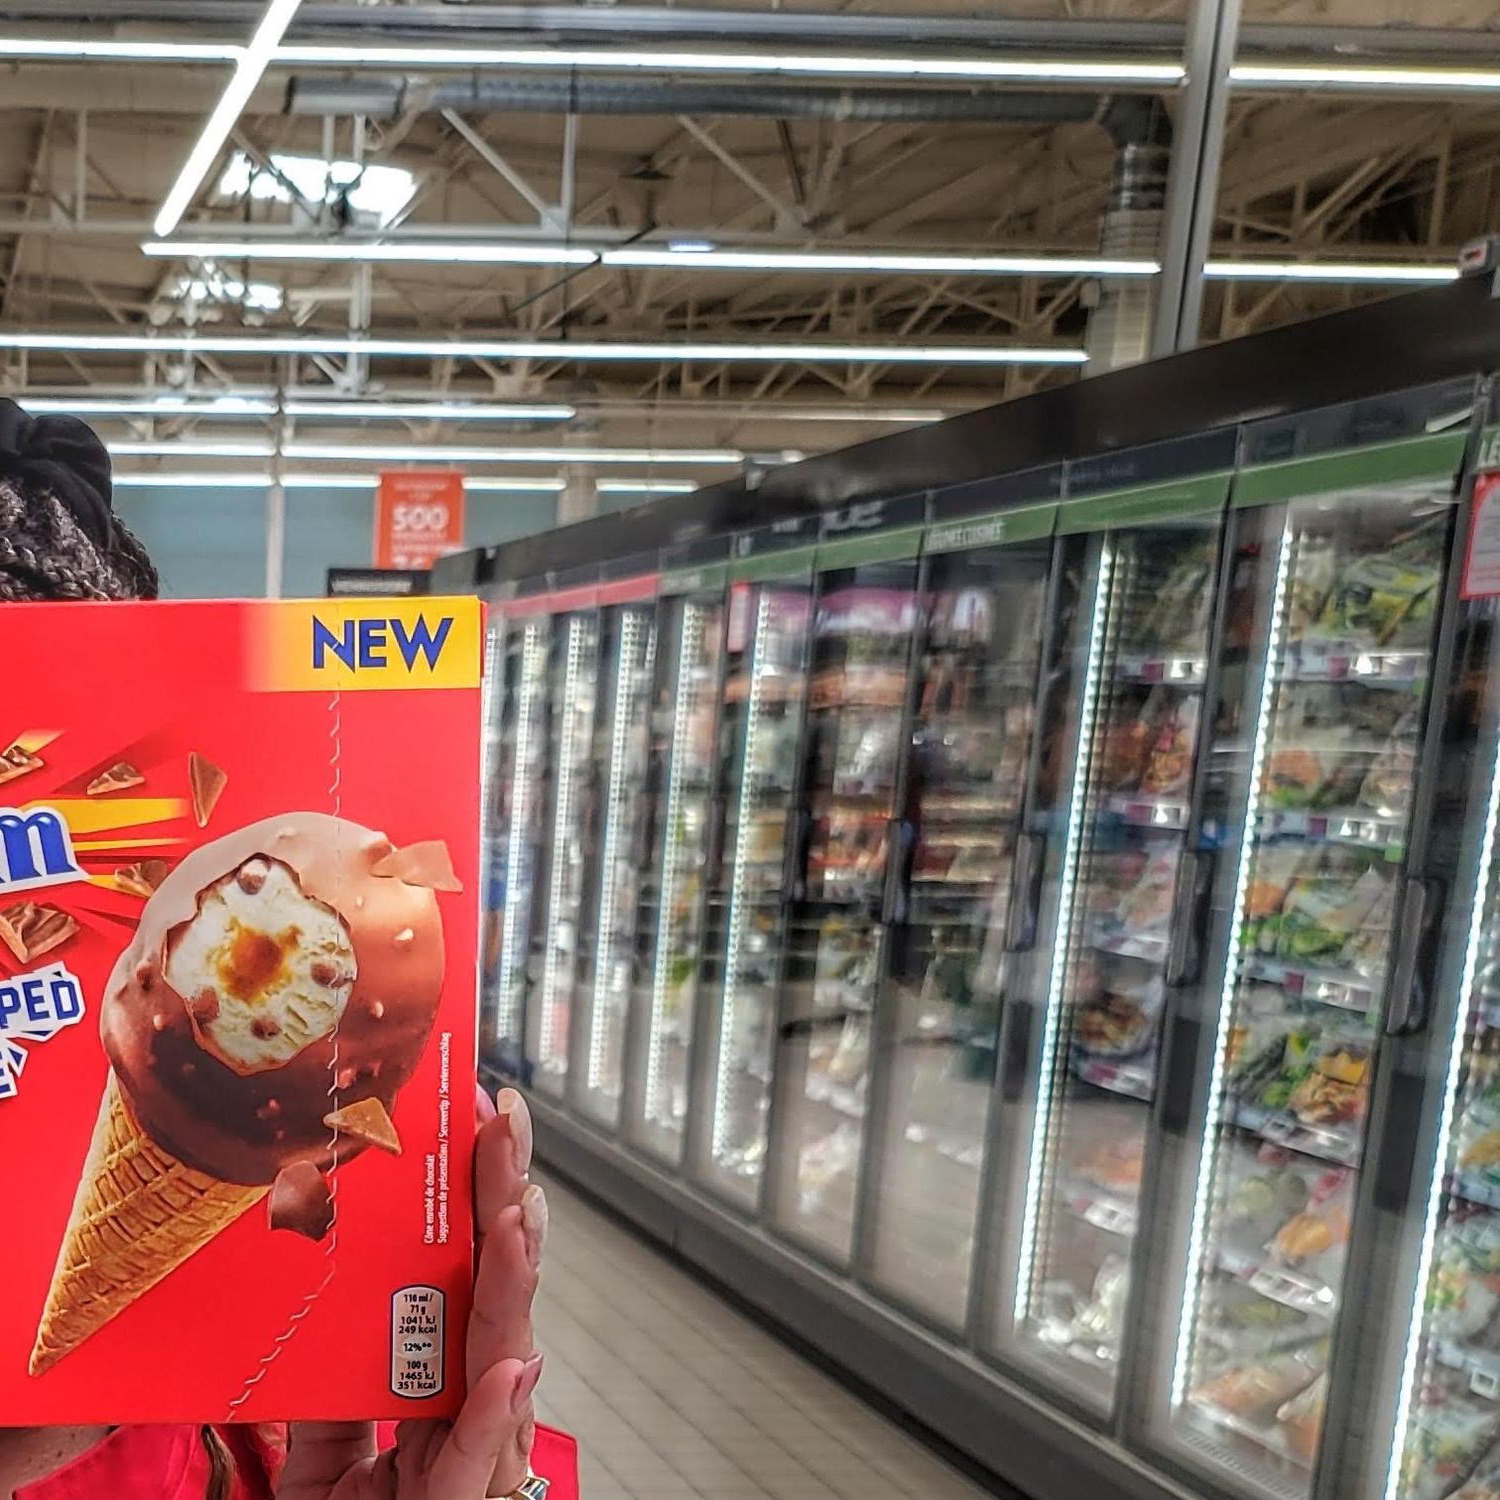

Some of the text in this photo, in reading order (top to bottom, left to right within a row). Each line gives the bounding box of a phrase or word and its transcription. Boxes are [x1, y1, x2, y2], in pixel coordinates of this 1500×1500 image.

[392, 504, 449, 531] 500
[311, 614, 454, 673] NEW
[404, 1294, 418, 1303] 110
[410, 1305, 426, 1315] 71 g
[401, 1316, 436, 1325] 1041 kJ
[398, 1325, 437, 1334] 249 kcal
[406, 1361, 428, 1371] 100 g
[400, 1371, 435, 1380] 1465 kJ
[397, 1380, 436, 1389] 351 kcal
